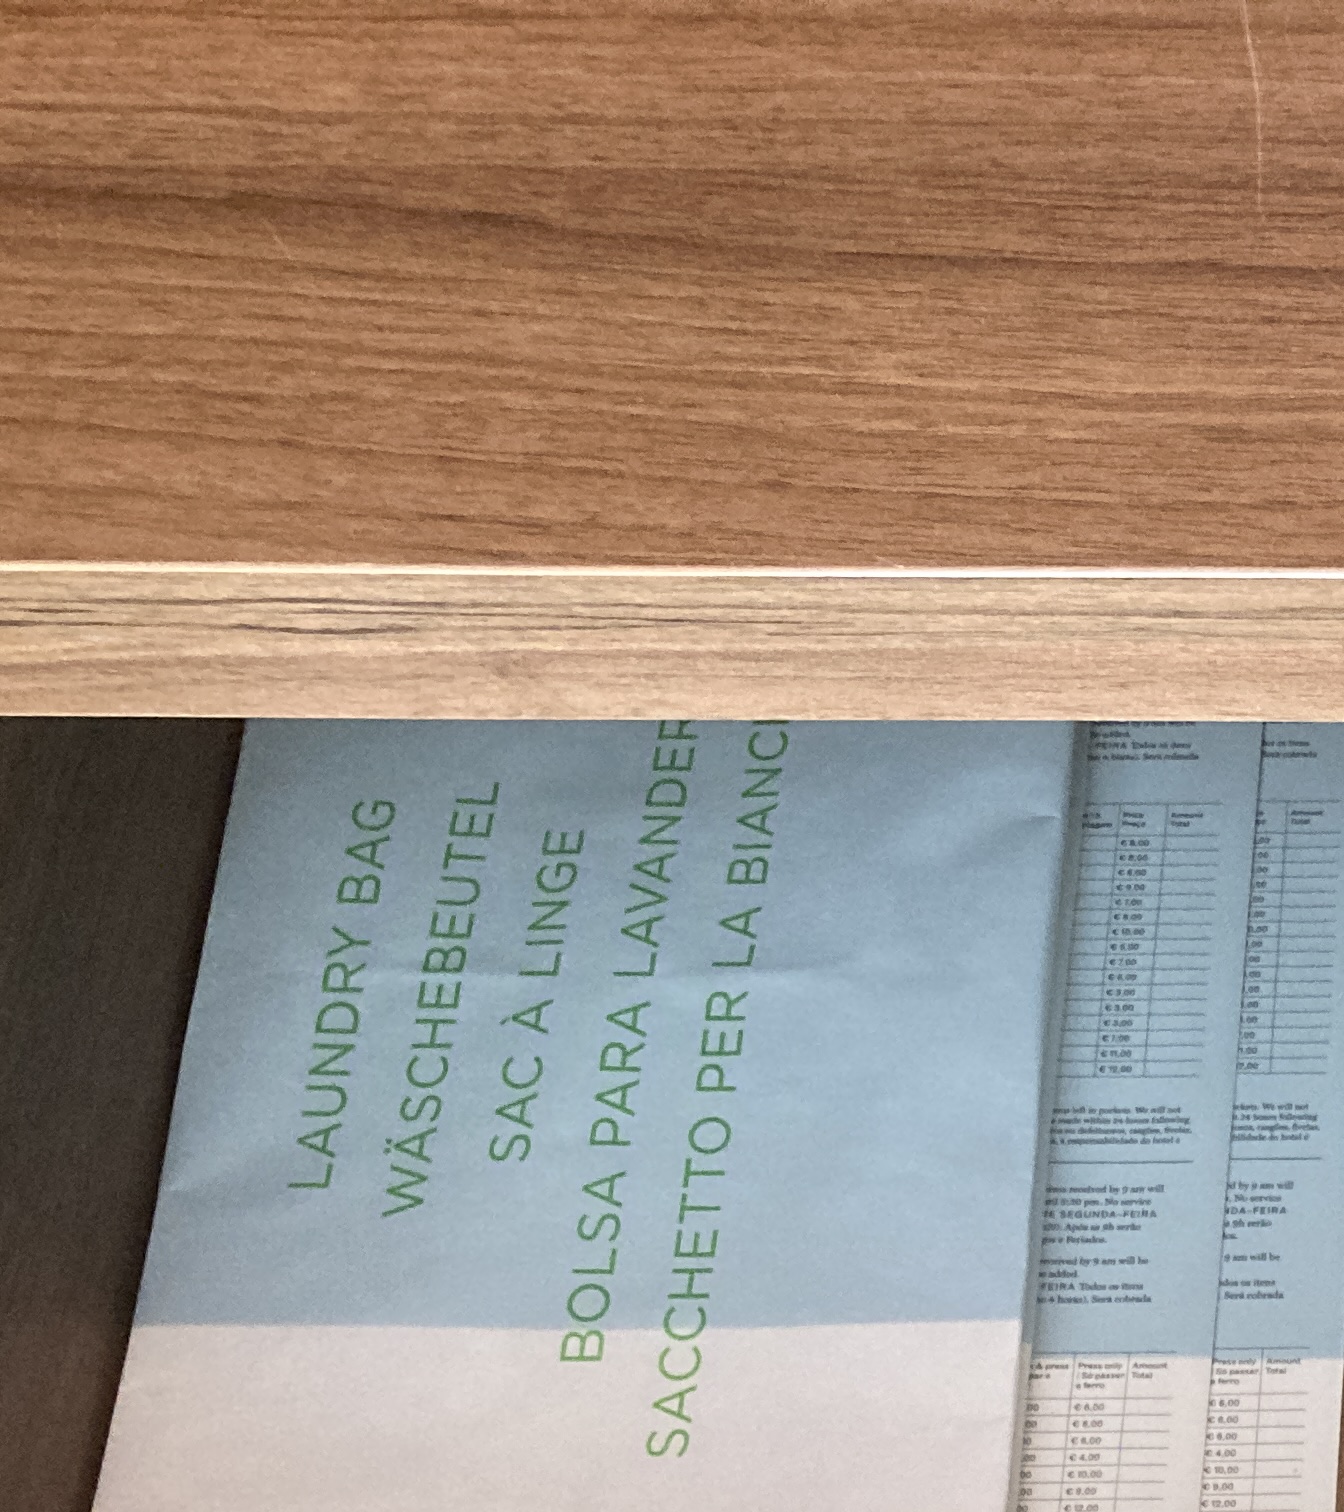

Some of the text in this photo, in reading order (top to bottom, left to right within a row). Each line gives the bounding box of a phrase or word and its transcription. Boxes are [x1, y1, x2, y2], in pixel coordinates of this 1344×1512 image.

[288, 799, 397, 1190] LAUNDRY BAG
[381, 781, 500, 1218] WÄSCHEBEUTEL
[488, 829, 585, 1162] SAC À LINGE
[589, 1001, 652, 1148] PARA
[646, 720, 790, 1458] SACCHETTO PER LA BIANC
[560, 1171, 627, 1362] BOLSA
